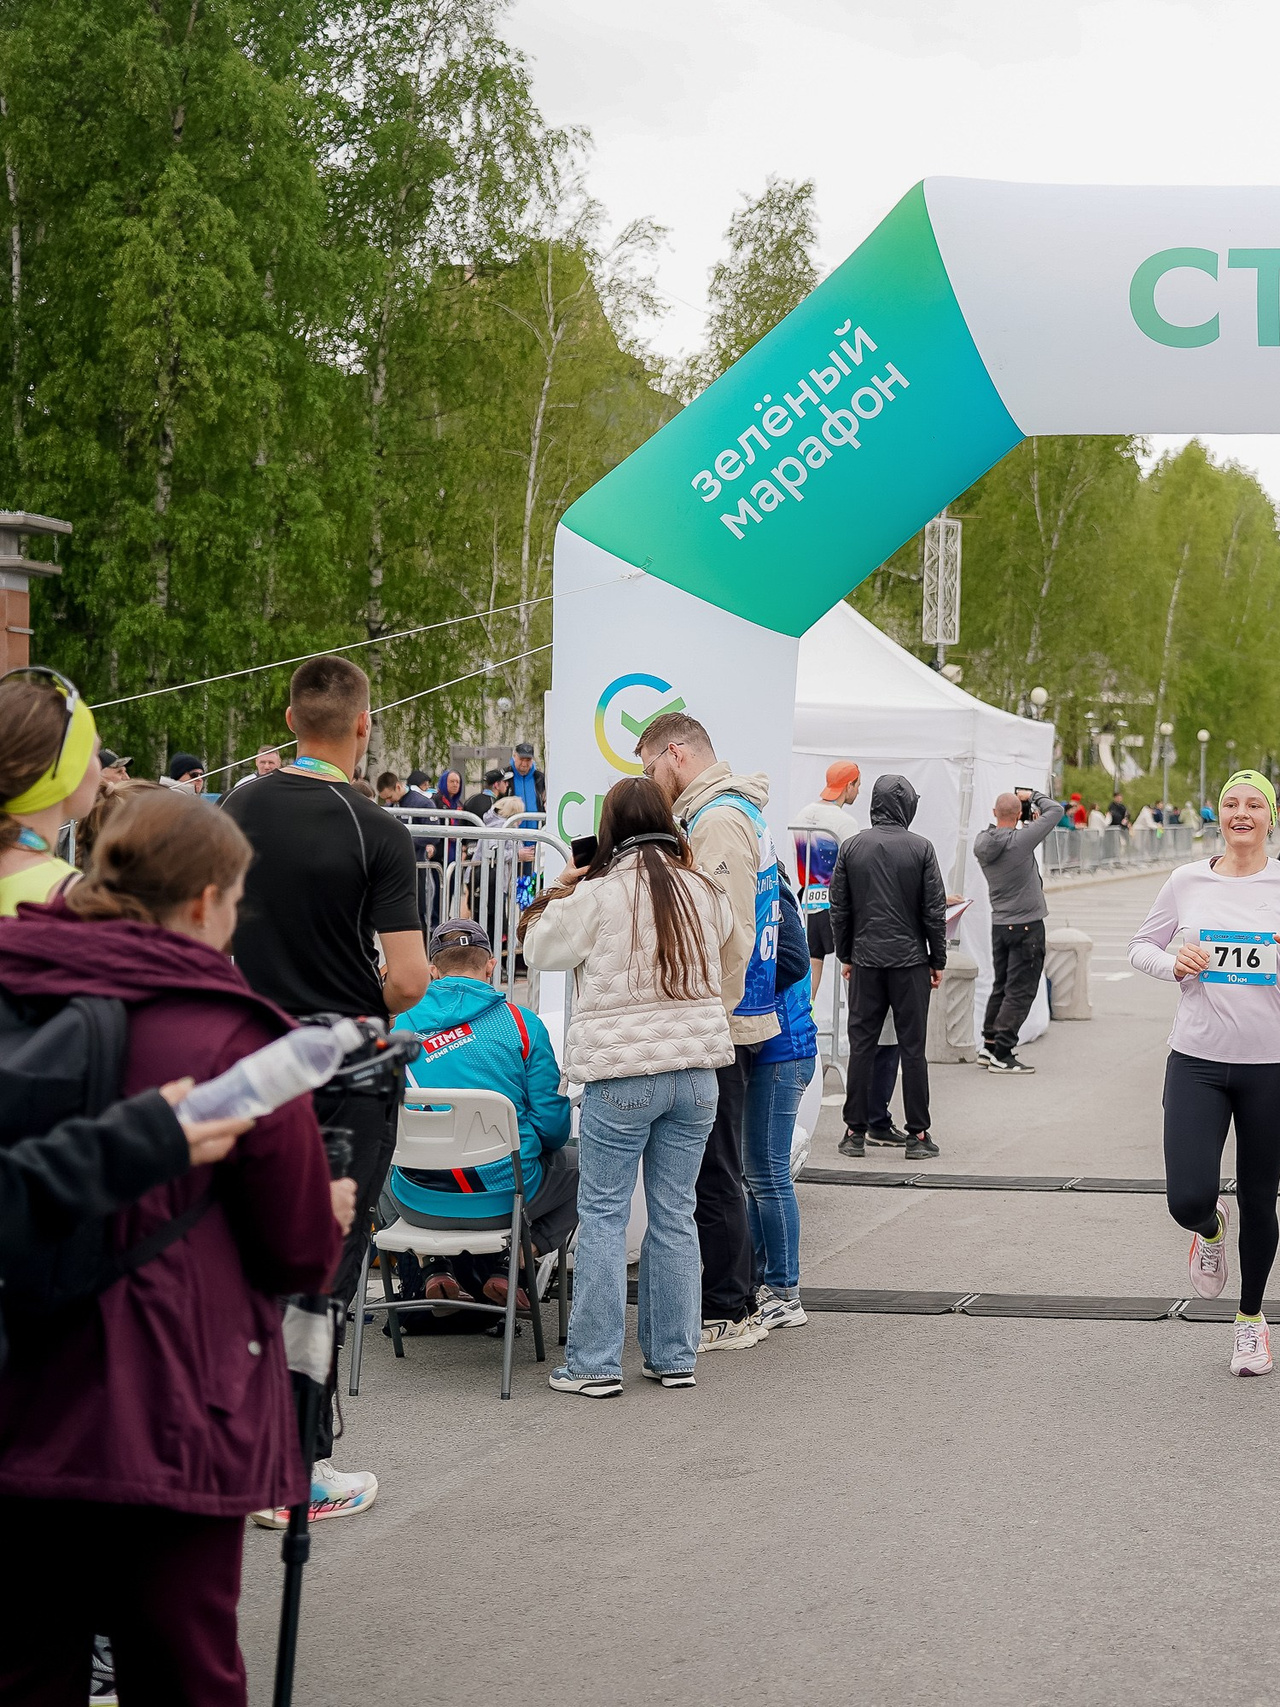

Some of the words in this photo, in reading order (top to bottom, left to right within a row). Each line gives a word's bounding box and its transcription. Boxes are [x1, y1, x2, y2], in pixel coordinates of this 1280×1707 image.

[690, 318, 878, 503] зелёный
[719, 361, 911, 541] марафон
[809, 891, 827, 901] 805
[1214, 946, 1261, 969] 716
[428, 1027, 466, 1049] TIME
[424, 1047, 449, 1064] ВРЕМЯ
